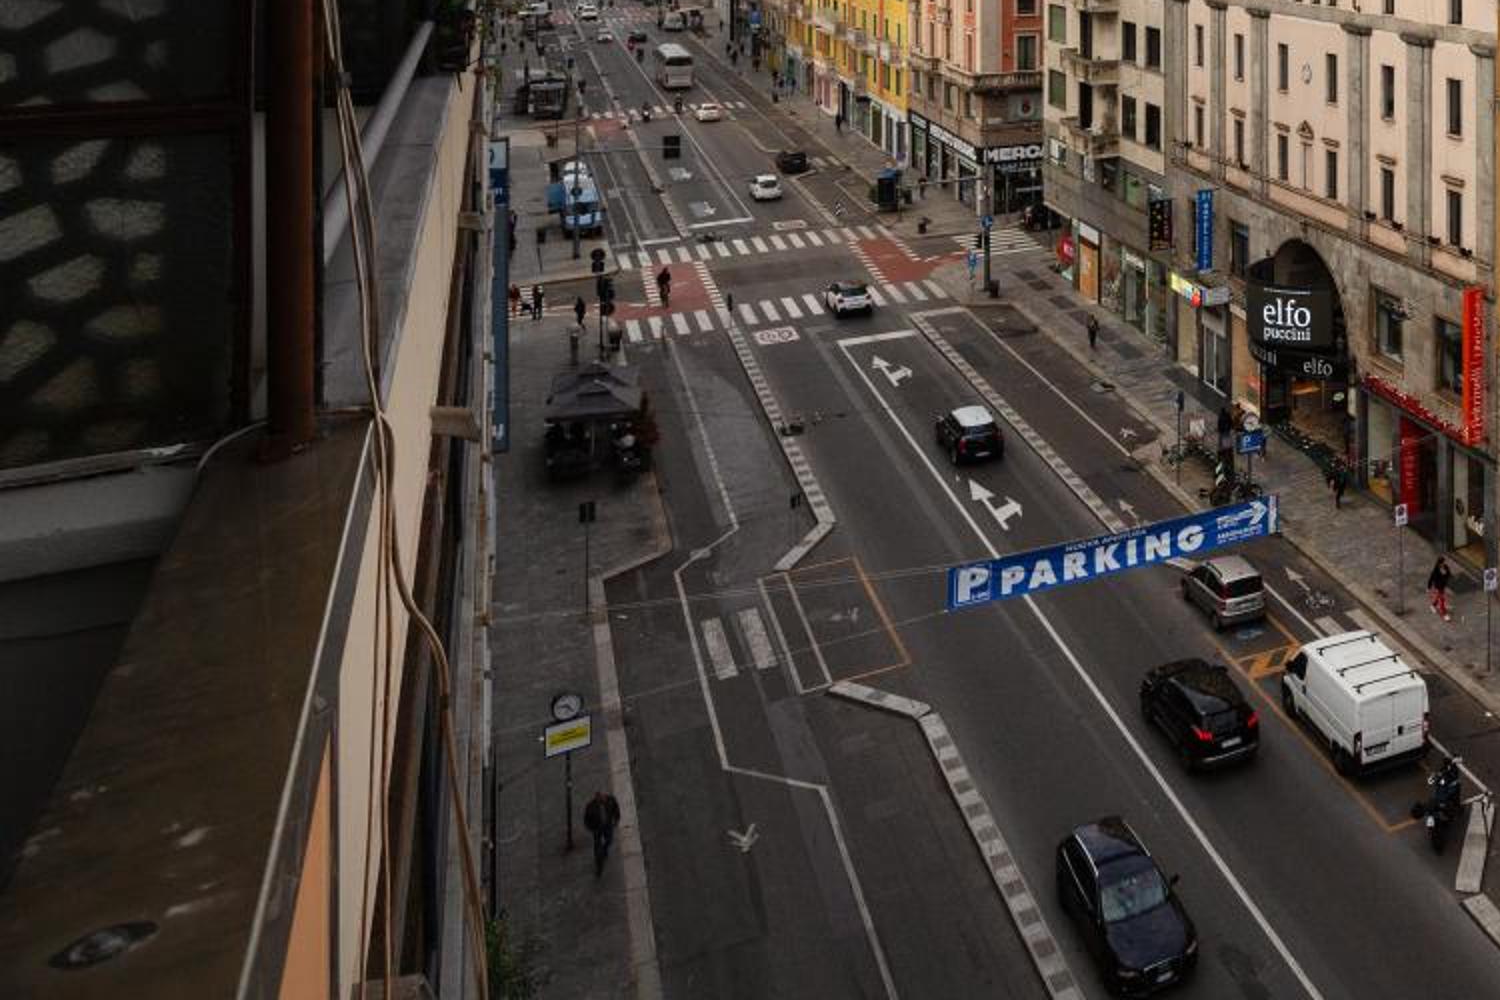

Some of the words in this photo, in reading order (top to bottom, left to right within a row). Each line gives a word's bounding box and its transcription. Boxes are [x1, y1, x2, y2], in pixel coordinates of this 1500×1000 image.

[1263, 297, 1311, 327] elfo
[1263, 327, 1311, 341] puccini
[1303, 356, 1333, 376] elfo
[957, 567, 989, 602] P
[1001, 525, 1205, 595] PARKING
